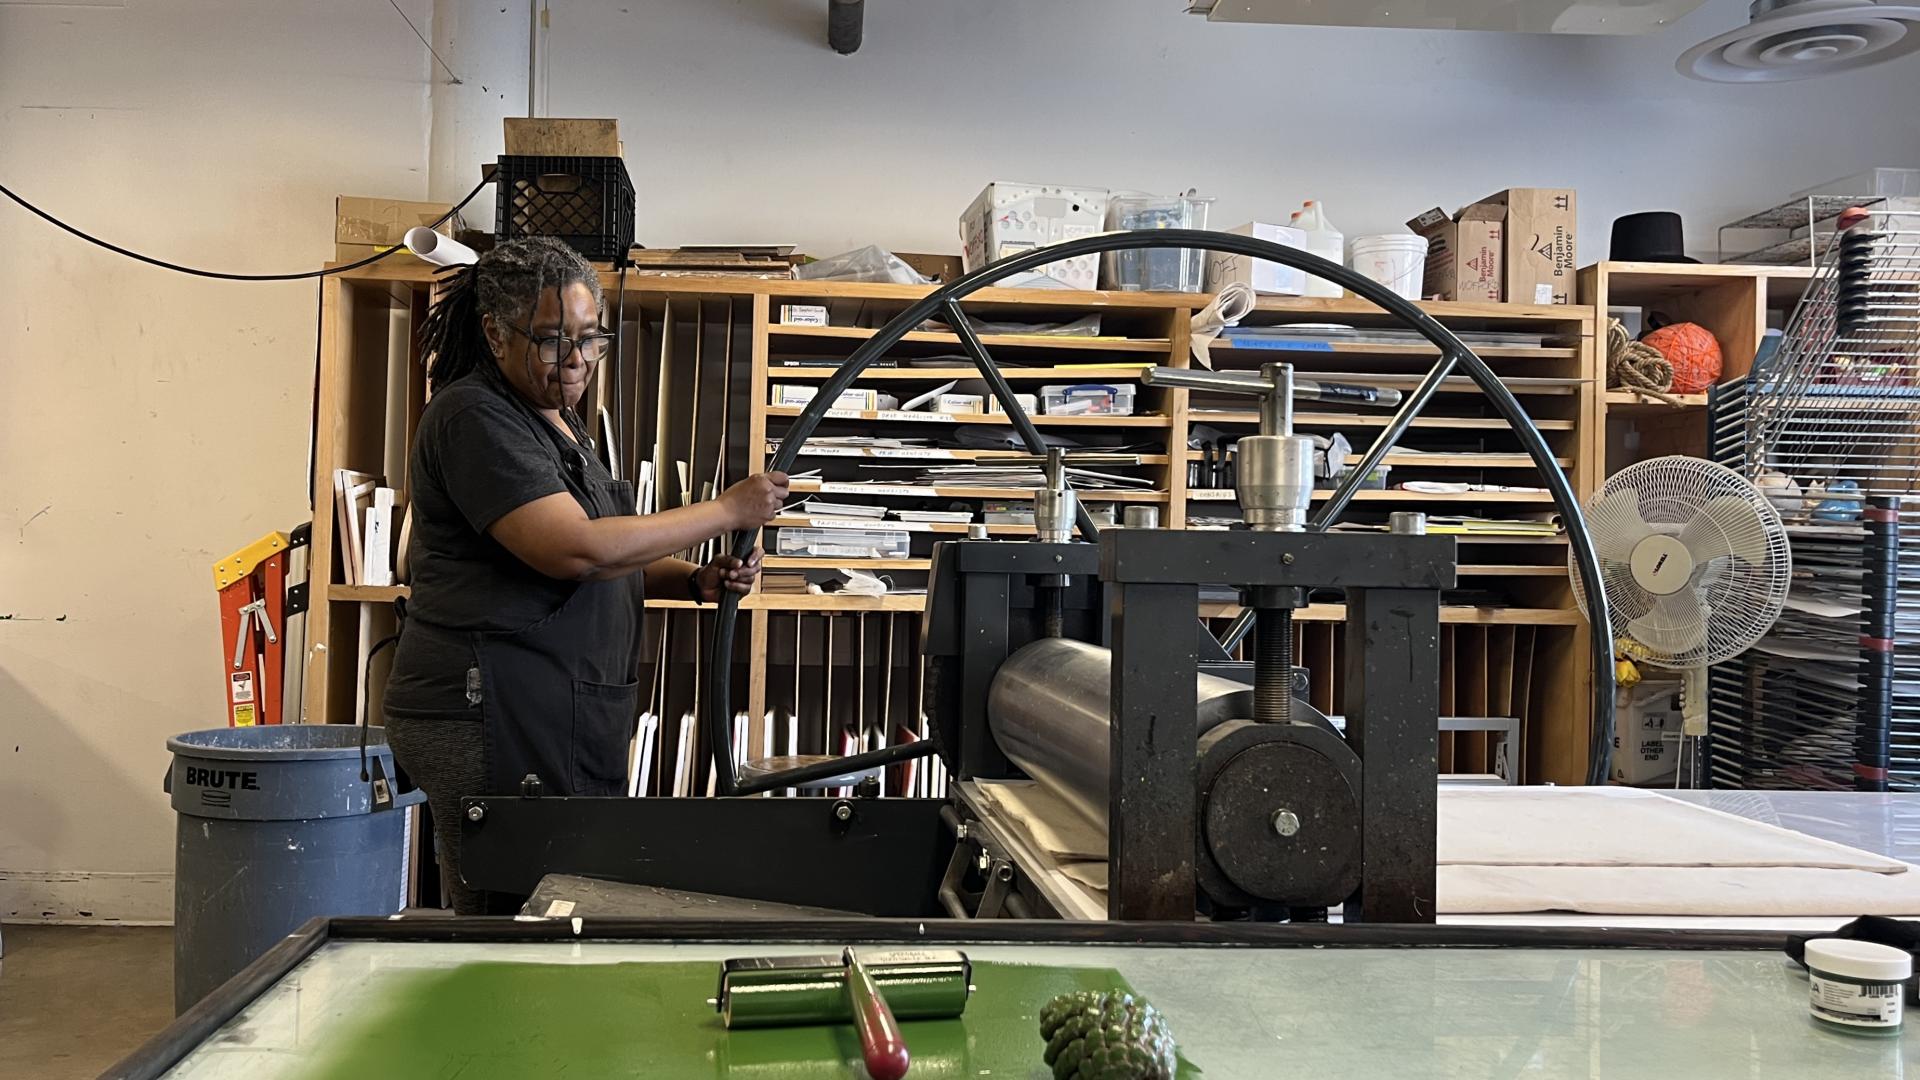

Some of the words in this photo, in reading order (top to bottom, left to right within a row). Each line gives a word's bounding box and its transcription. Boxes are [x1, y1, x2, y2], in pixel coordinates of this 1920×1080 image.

[1479, 246, 1487, 282] Benjamin
[1487, 251, 1495, 278] Moore
[1553, 225, 1563, 277] Benjamin
[1564, 233, 1573, 269] Moore
